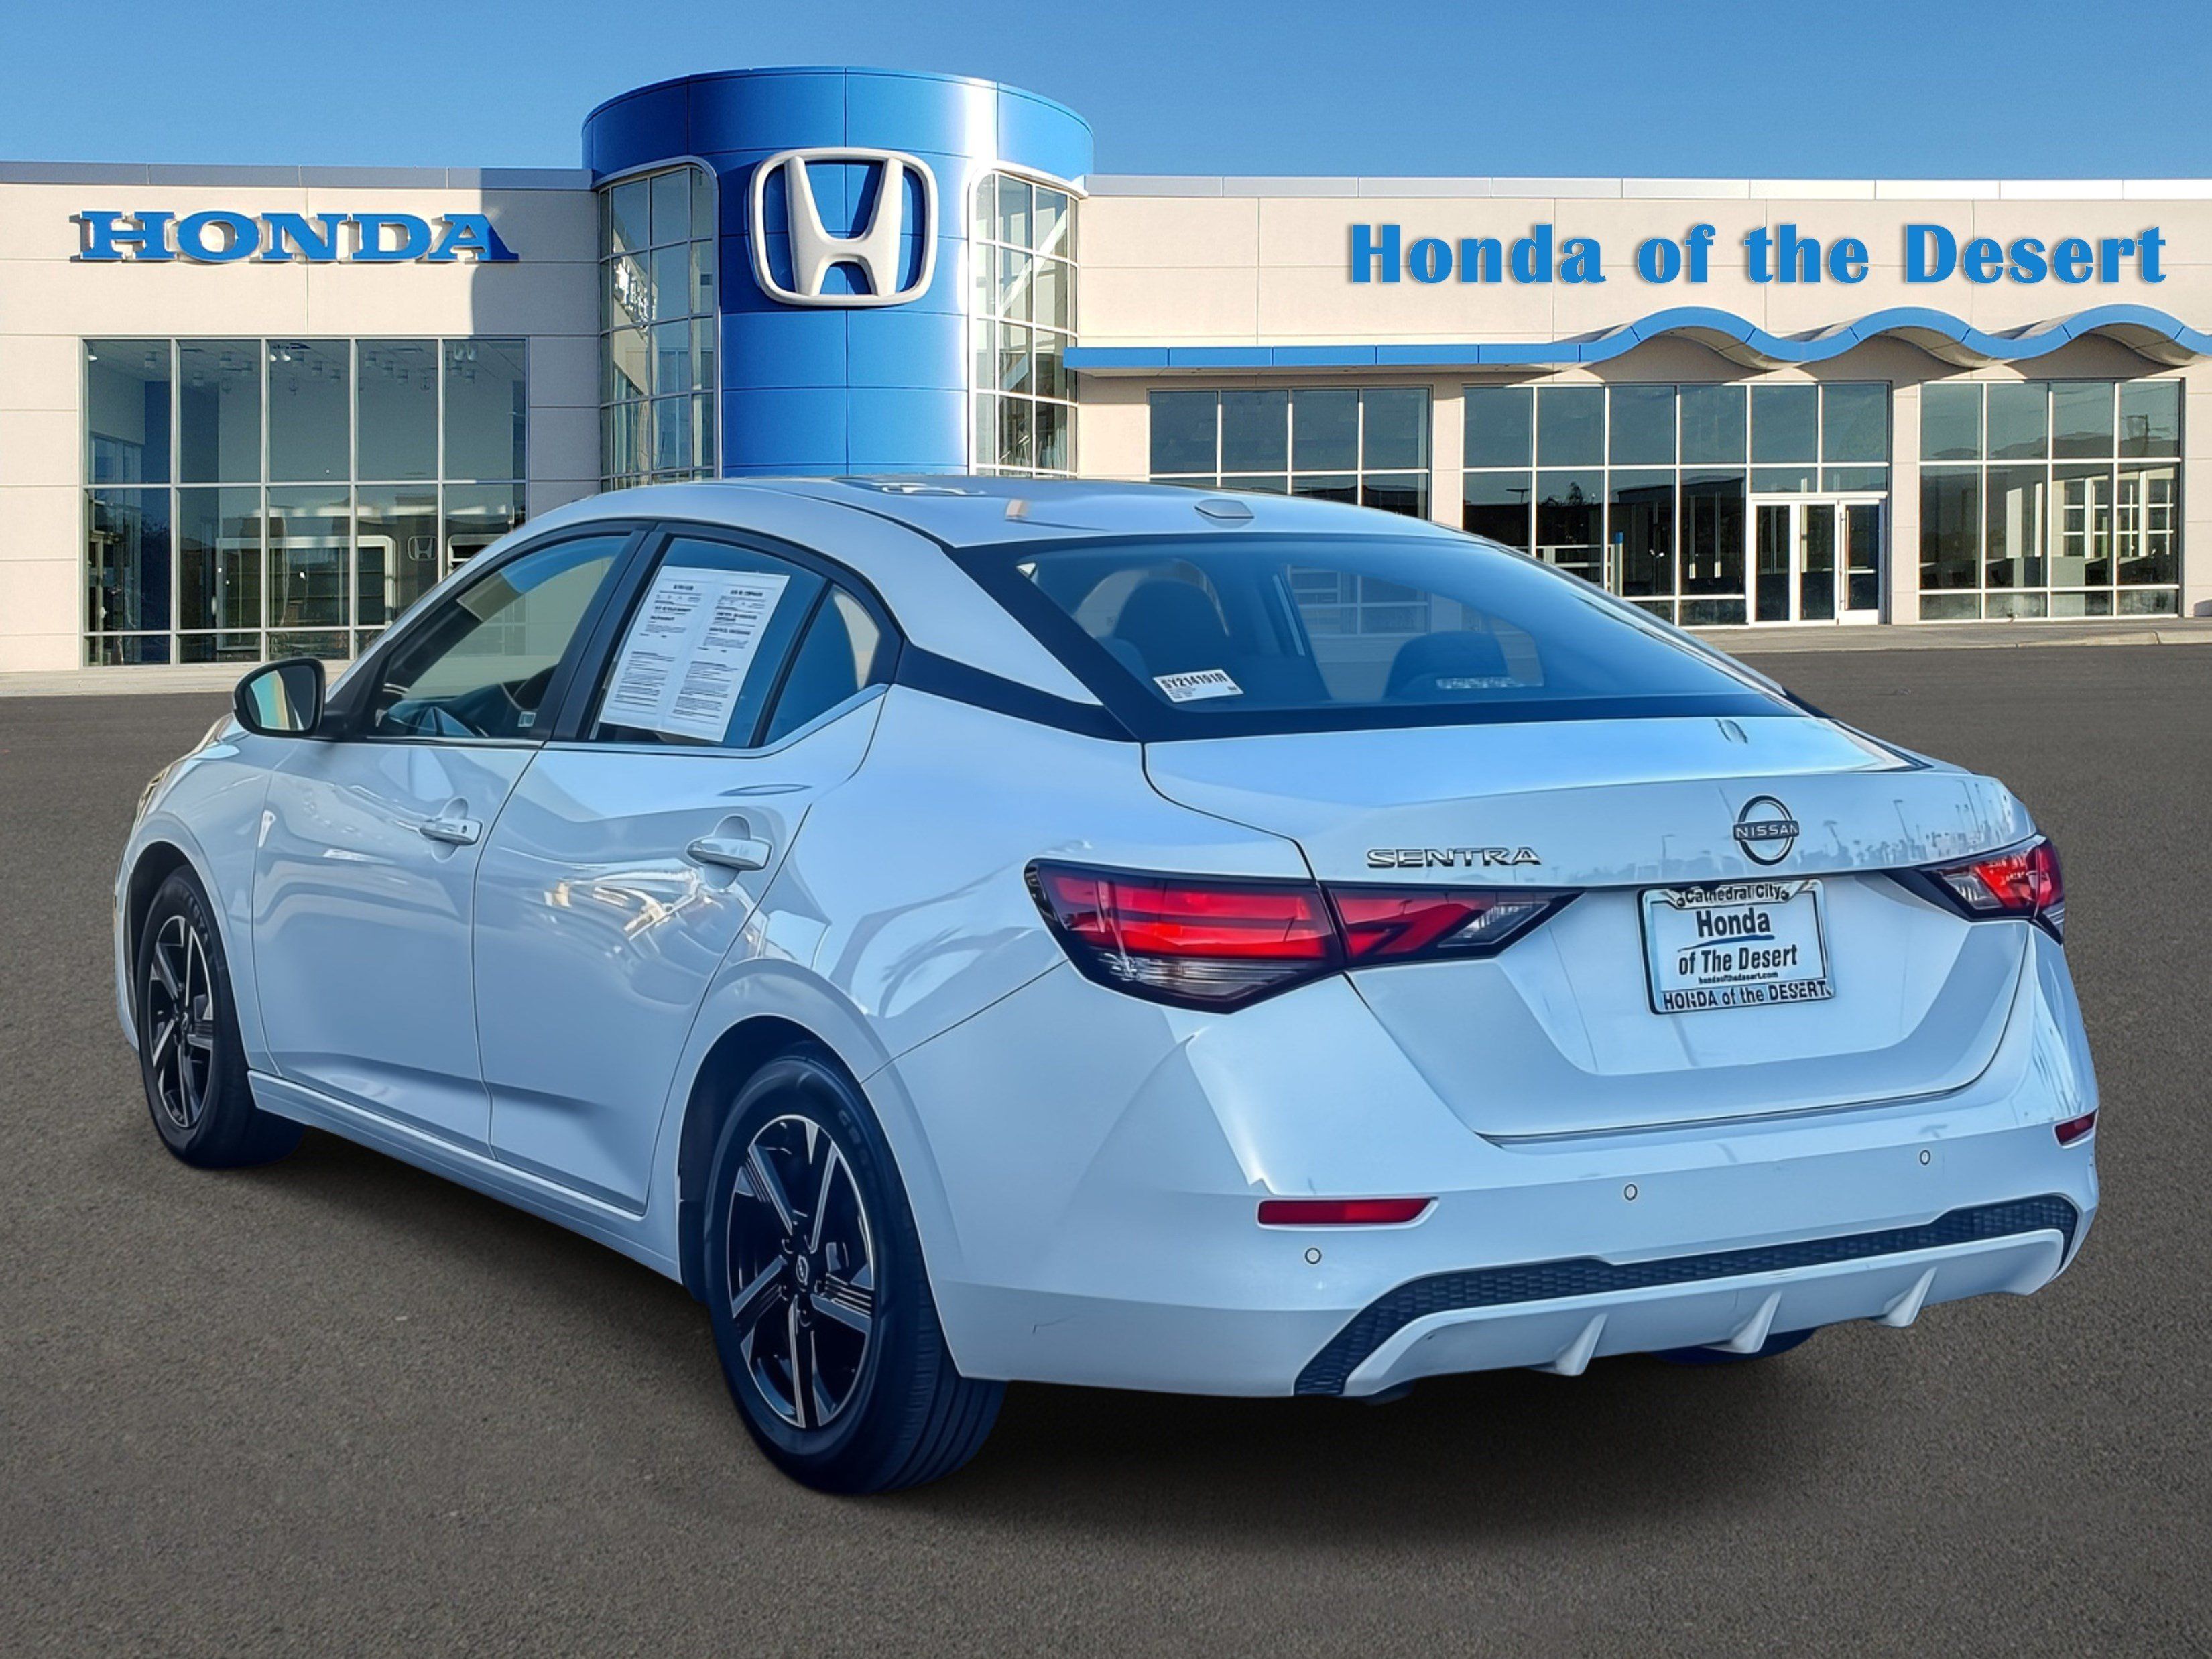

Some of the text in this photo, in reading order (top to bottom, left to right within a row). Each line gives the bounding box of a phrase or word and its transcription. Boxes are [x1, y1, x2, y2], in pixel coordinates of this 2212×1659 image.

[80, 210, 519, 262] HONDA
[1351, 223, 2167, 285] Honda of the Desert
[1735, 824, 1798, 838] NISSAN
[1367, 847, 1542, 868] SENTRA
[1684, 882, 1782, 904] Cathedral City
[1695, 906, 1771, 938] Honda
[1678, 944, 1798, 975] of The Desert
[1663, 980, 1827, 1011] HONDA of the DESERT
